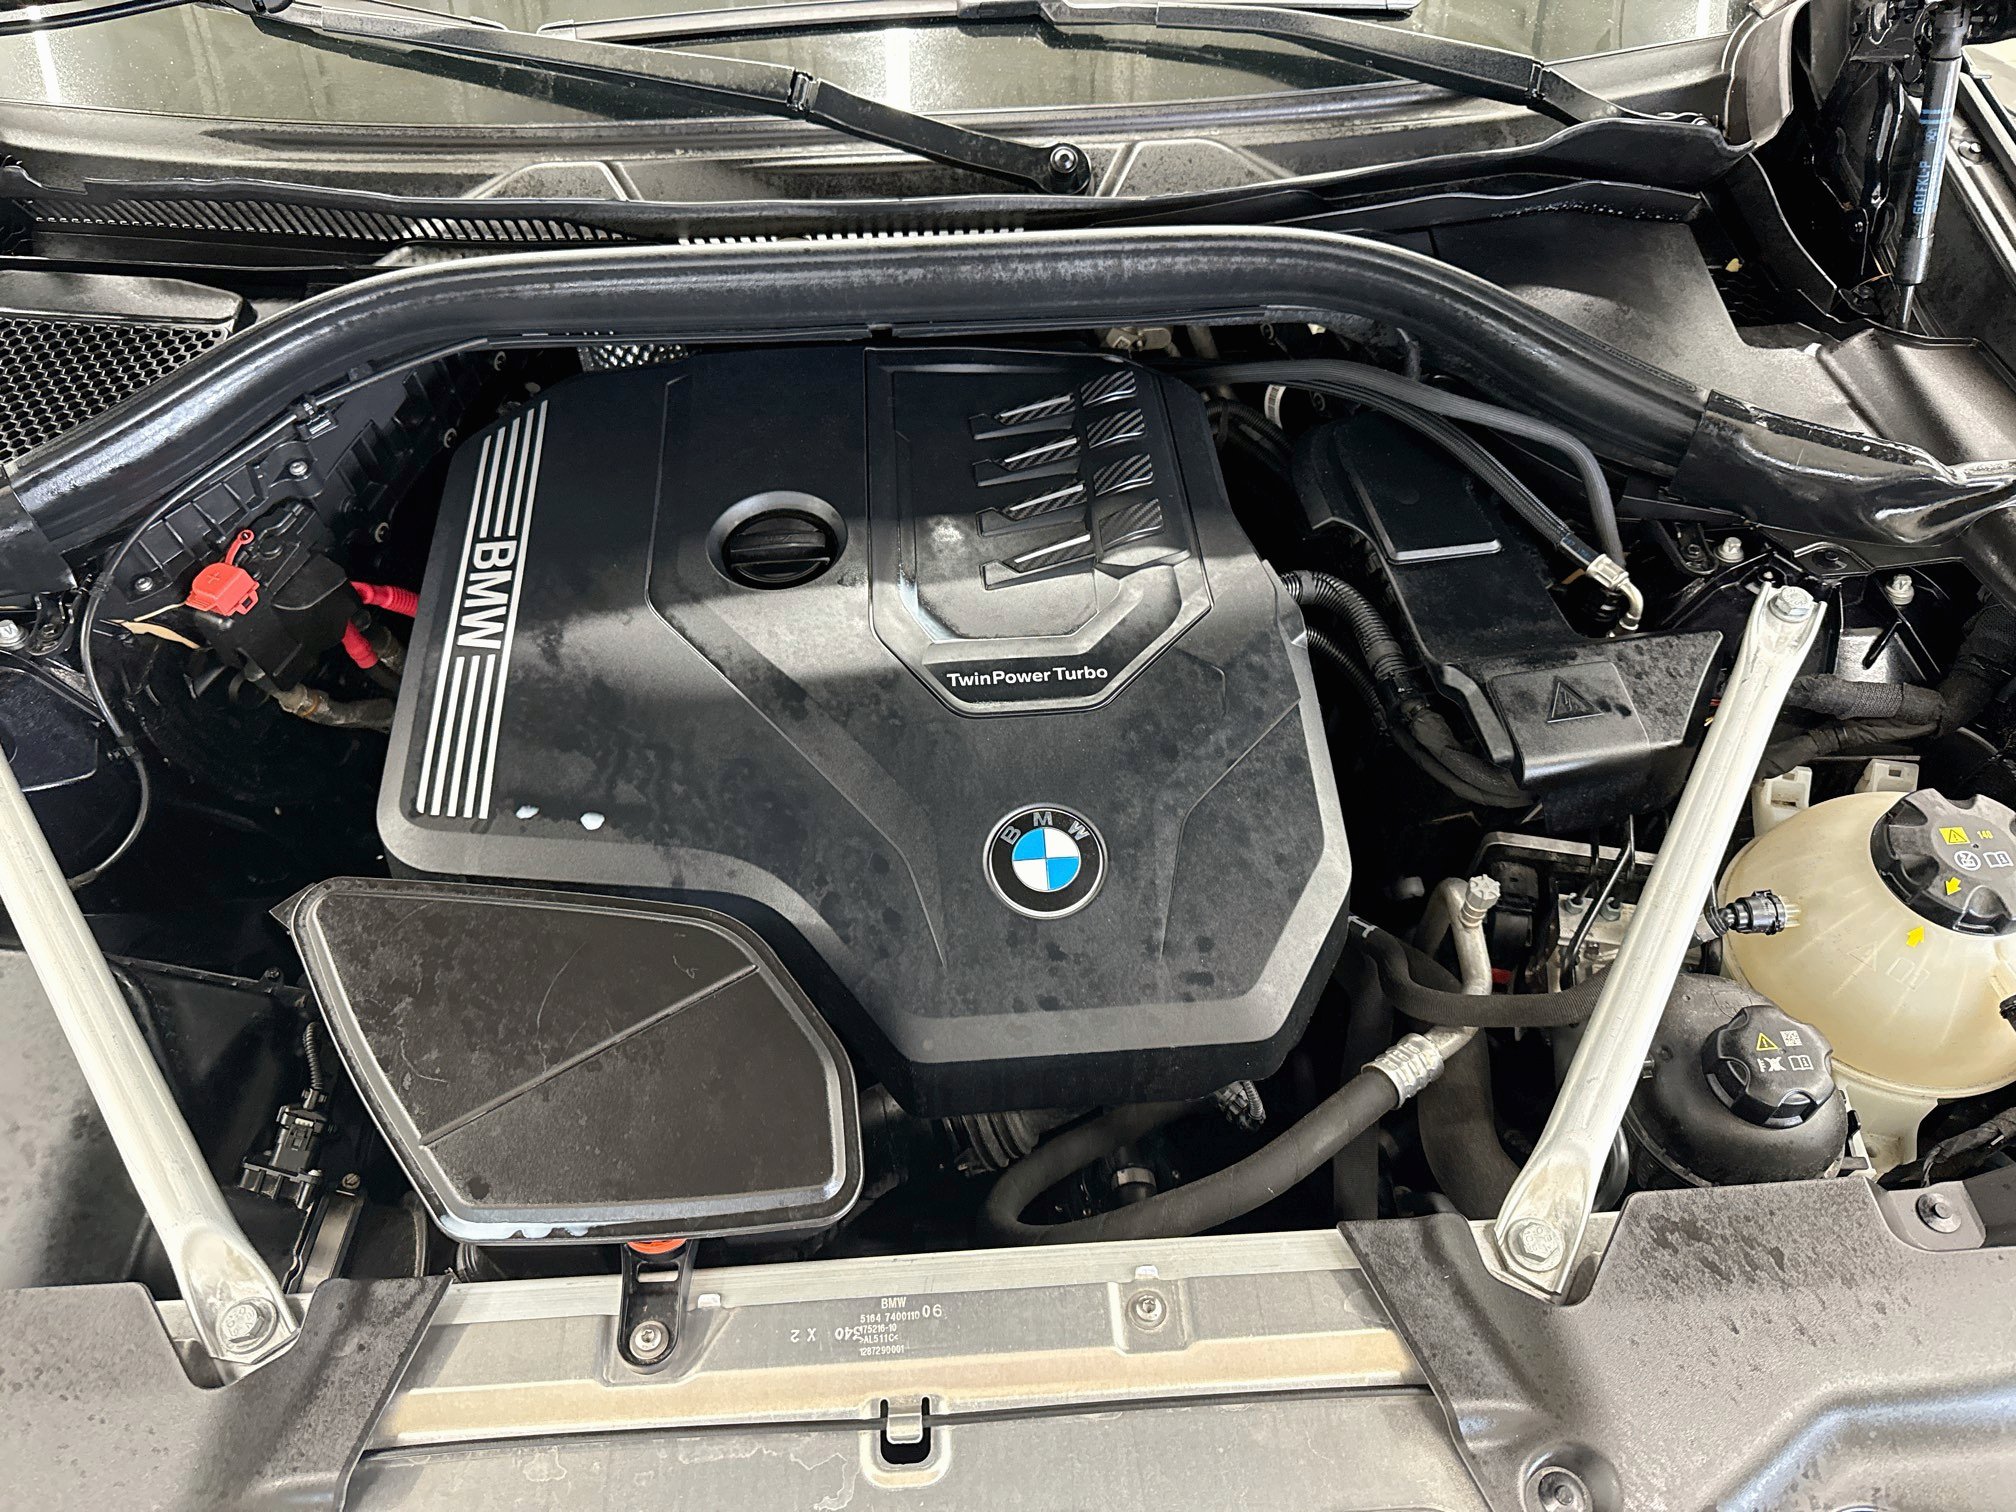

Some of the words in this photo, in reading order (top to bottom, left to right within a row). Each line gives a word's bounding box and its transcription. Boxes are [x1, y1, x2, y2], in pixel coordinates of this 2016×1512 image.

[457, 540, 517, 650] BMW
[947, 670, 1051, 687] TwinPower
[1053, 666, 1108, 681] Turbo
[1000, 811, 1090, 845] BMW
[1977, 830, 1994, 840] 140
[881, 1297, 907, 1309] BMW
[885, 1311, 920, 1321] 7400110
